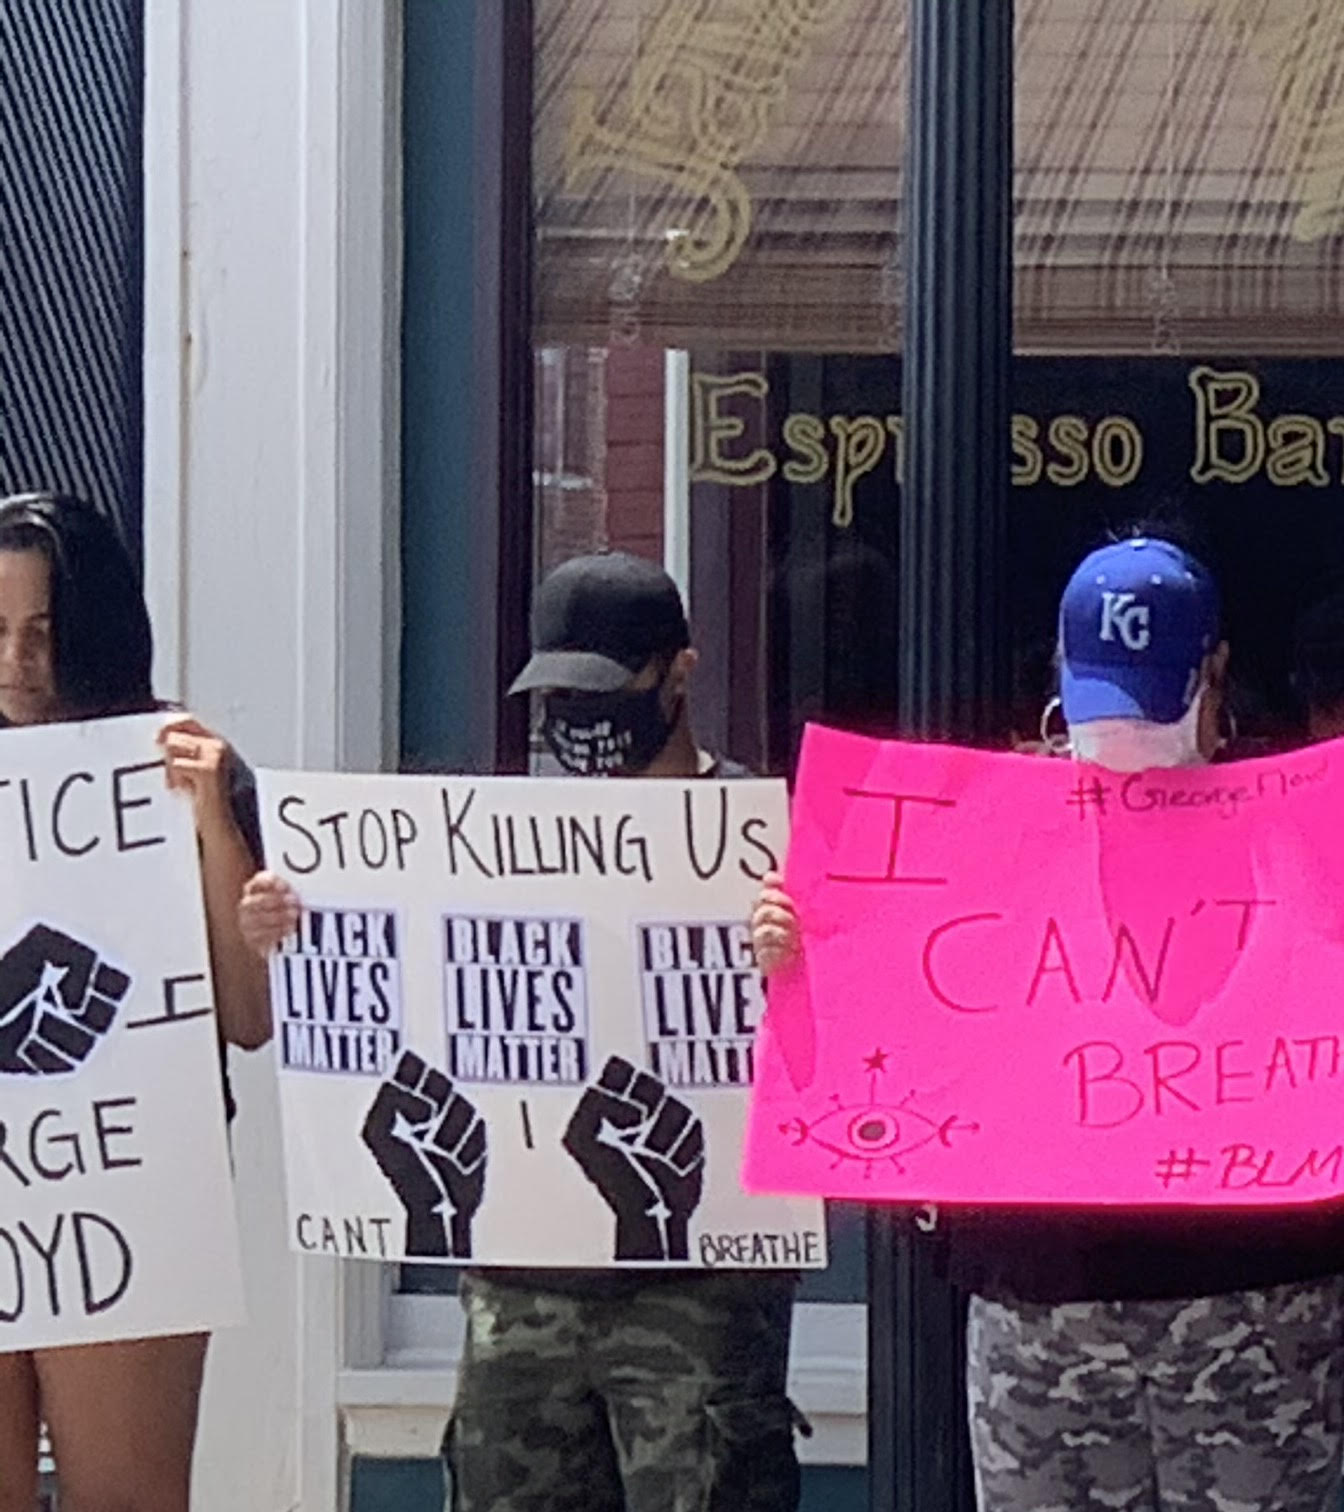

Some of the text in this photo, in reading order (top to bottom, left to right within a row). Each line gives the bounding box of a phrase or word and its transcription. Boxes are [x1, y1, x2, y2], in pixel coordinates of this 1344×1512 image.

[689, 374, 1144, 526] Espsso
[1100, 591, 1150, 651] KC
[0, 759, 167, 862] ICE
[277, 786, 779, 883] STOP KILLING US
[826, 786, 956, 886] I
[450, 917, 572, 966] BLACK
[650, 925, 755, 971] BLAC
[921, 898, 1276, 1013] CAN'T
[284, 956, 391, 1025] LIVES
[456, 965, 576, 1033] LIVES
[655, 972, 767, 1037] LIVE
[286, 1024, 394, 1075] MATTER
[455, 1034, 580, 1083] MATTER
[655, 1039, 755, 1088] MATT
[519, 1099, 534, 1149] I
[296, 1214, 391, 1257] CANT
[699, 1232, 822, 1266] BREATHE
